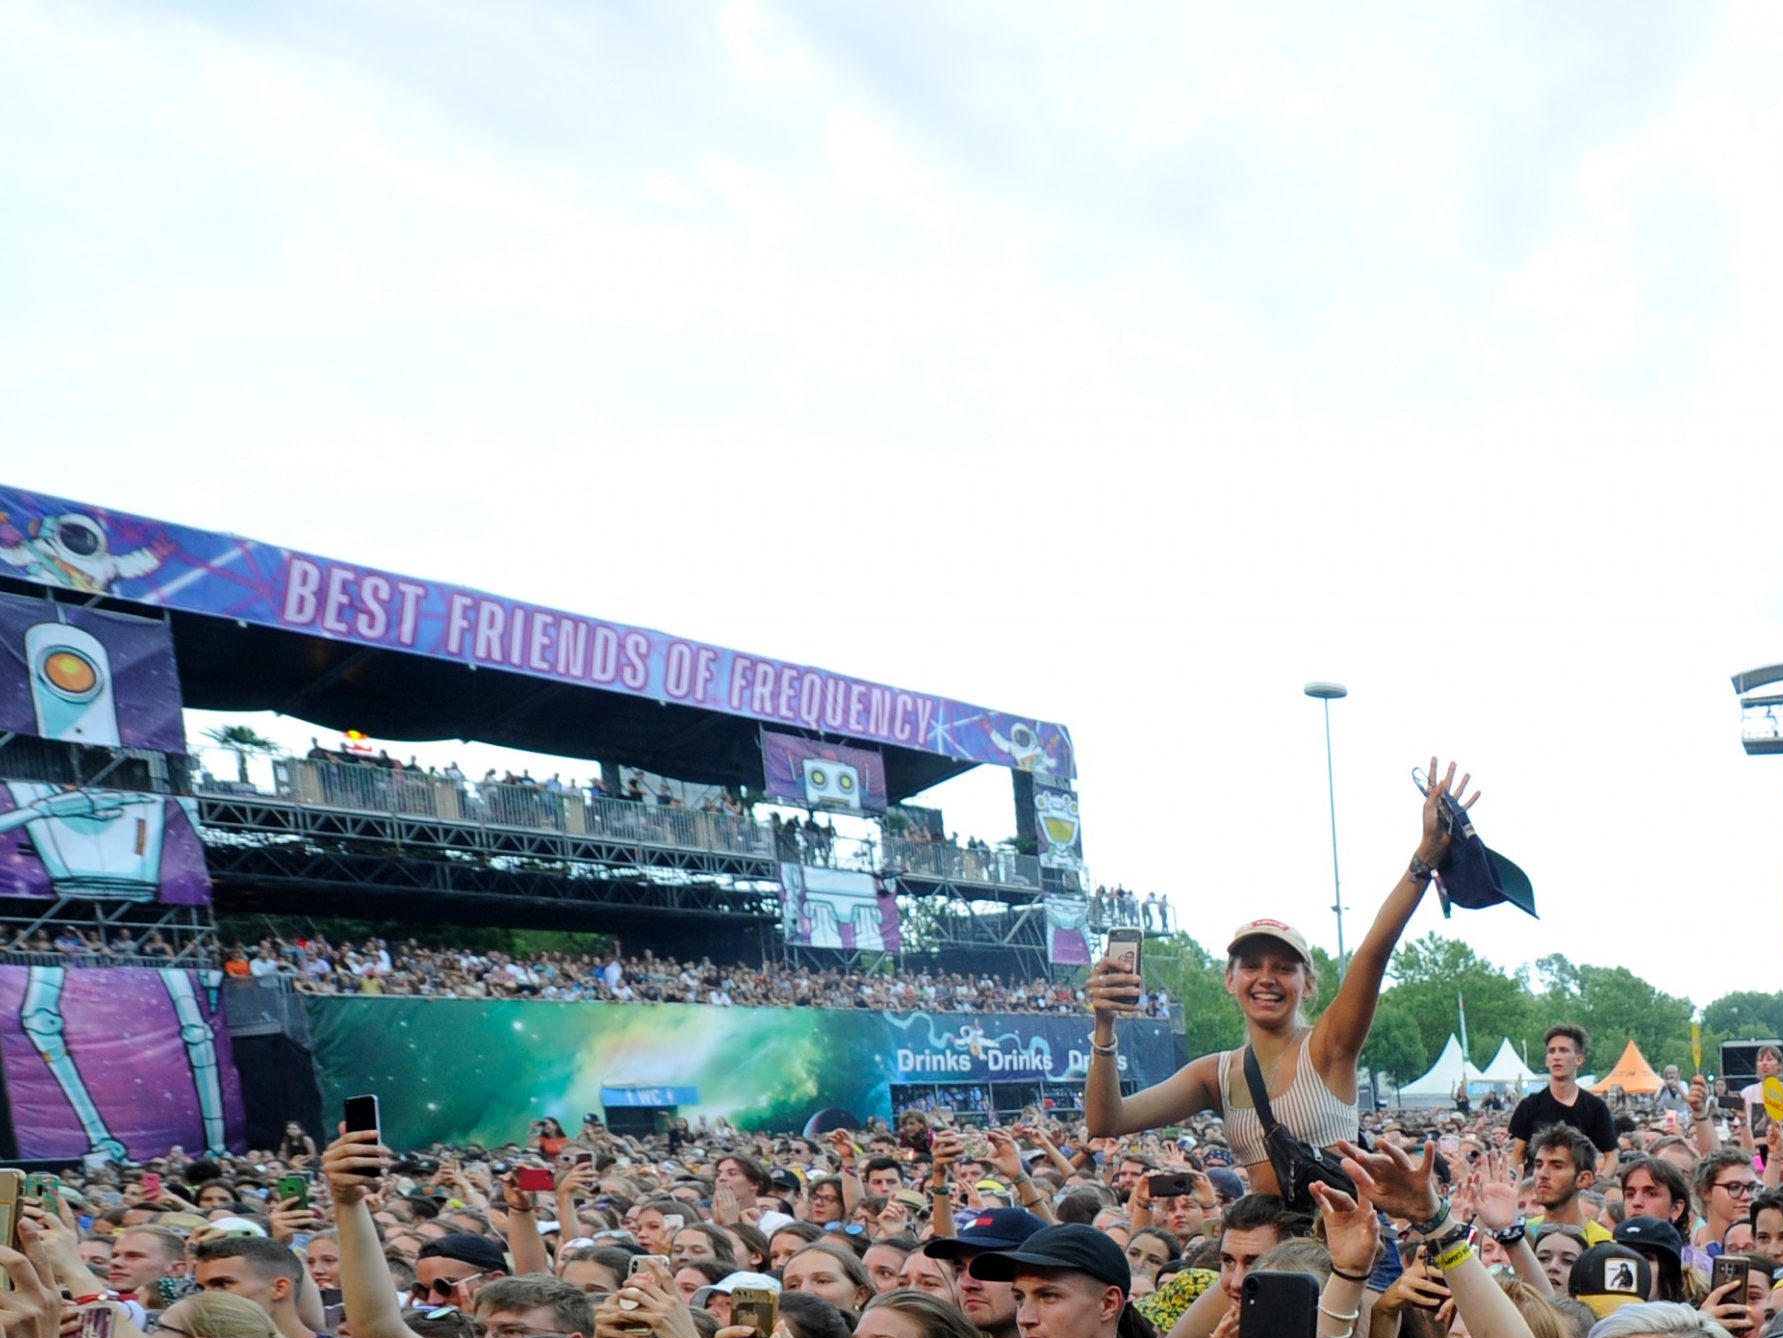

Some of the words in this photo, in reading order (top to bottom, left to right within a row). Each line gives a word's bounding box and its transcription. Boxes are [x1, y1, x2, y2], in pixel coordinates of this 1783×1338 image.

[283, 558, 425, 646] BEST
[448, 593, 649, 690] FRIENDS
[666, 642, 715, 700] OF
[730, 656, 932, 744] FREQUENCY
[897, 1049, 971, 1072] Drinks
[988, 1049, 1053, 1072] Drinks
[1068, 1050, 1127, 1072] Drs
